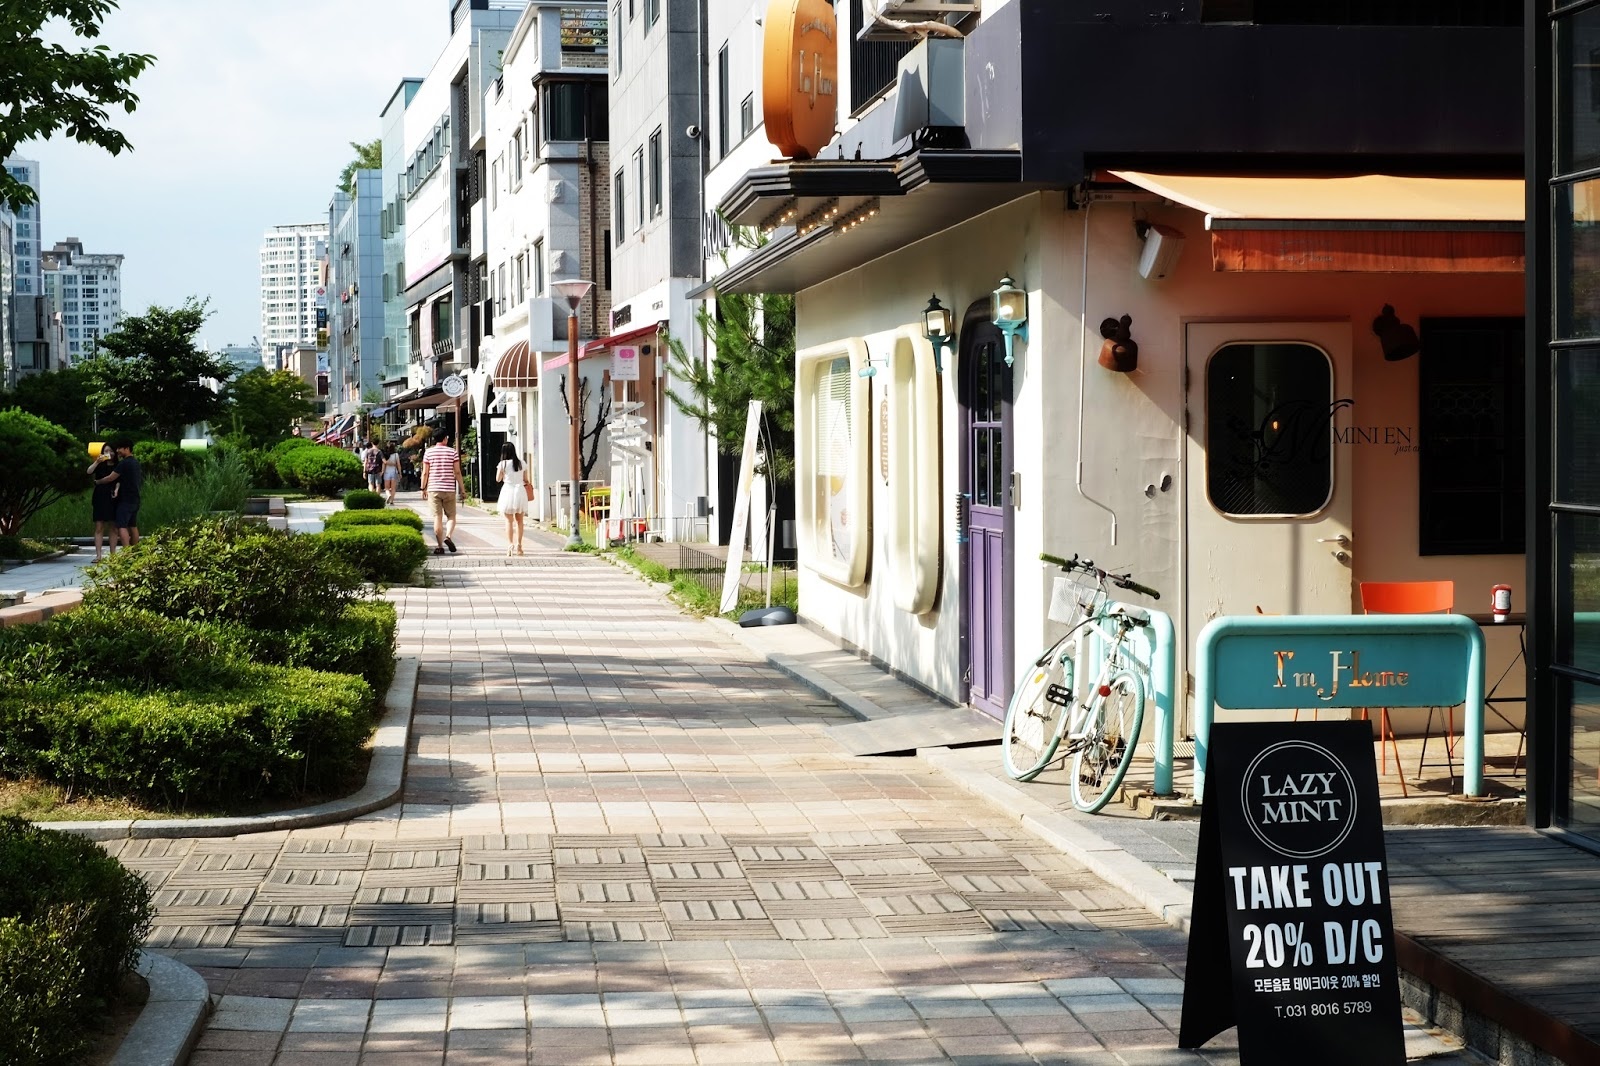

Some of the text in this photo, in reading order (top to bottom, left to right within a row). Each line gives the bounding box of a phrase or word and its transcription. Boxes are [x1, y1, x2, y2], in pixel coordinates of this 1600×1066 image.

[1332, 427, 1412, 444] MINI EN
[1273, 650, 1317, 687] I'm
[1260, 772, 1337, 797] LAZY
[1261, 799, 1343, 825] MINT
[1228, 861, 1383, 910] TAKE OUT
[1243, 919, 1384, 969] 20% D/C
[1254, 973, 1381, 993] 모든음료 테이크아웃 20% 할인
[1311, 1002, 1340, 1016] 8016
[1343, 1000, 1372, 1015] 5789
